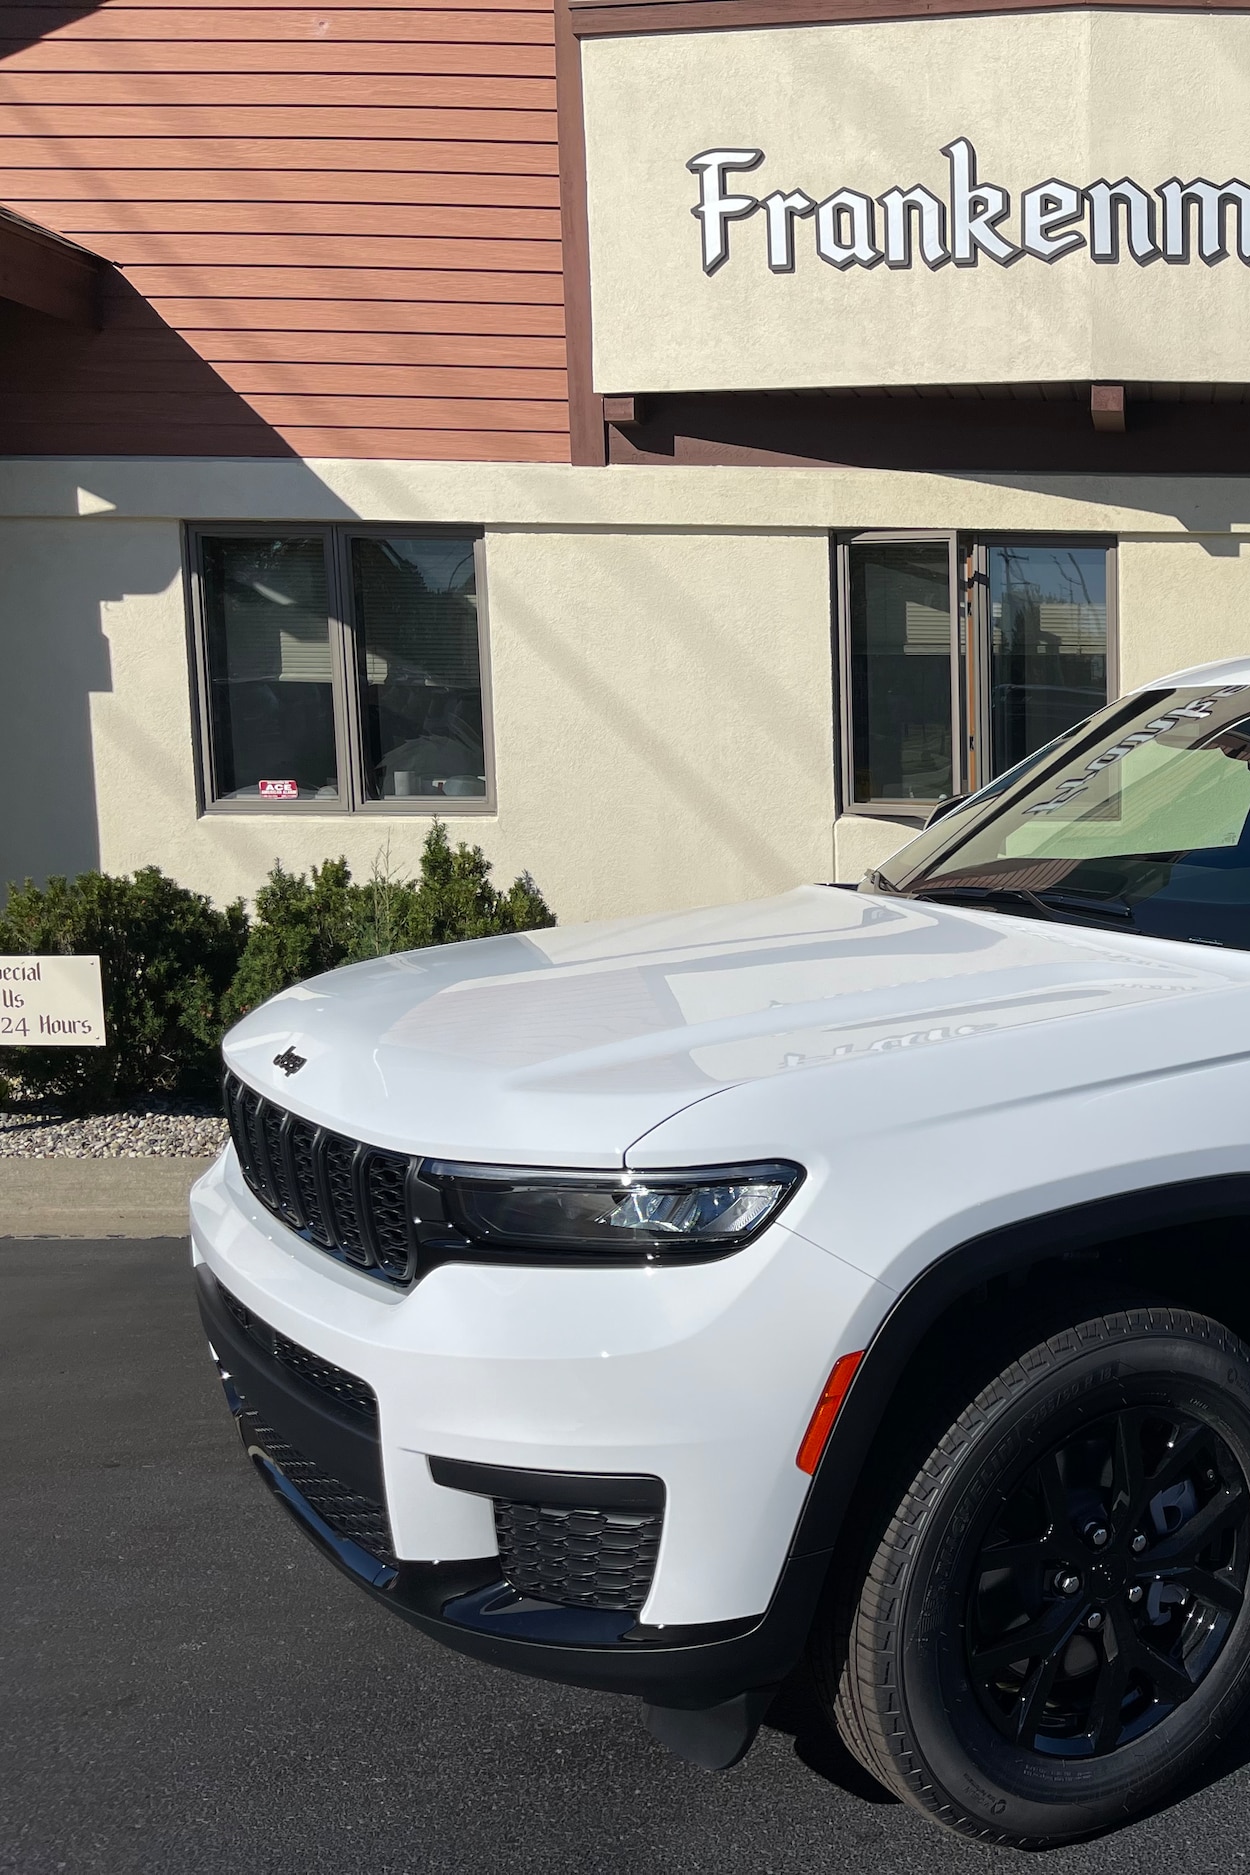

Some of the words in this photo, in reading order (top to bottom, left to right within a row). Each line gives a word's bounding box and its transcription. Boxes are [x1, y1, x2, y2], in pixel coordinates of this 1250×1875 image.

[0, 962, 41, 981] ecial
[1, 1017, 30, 1037] 24
[39, 1014, 92, 1035] Hours
